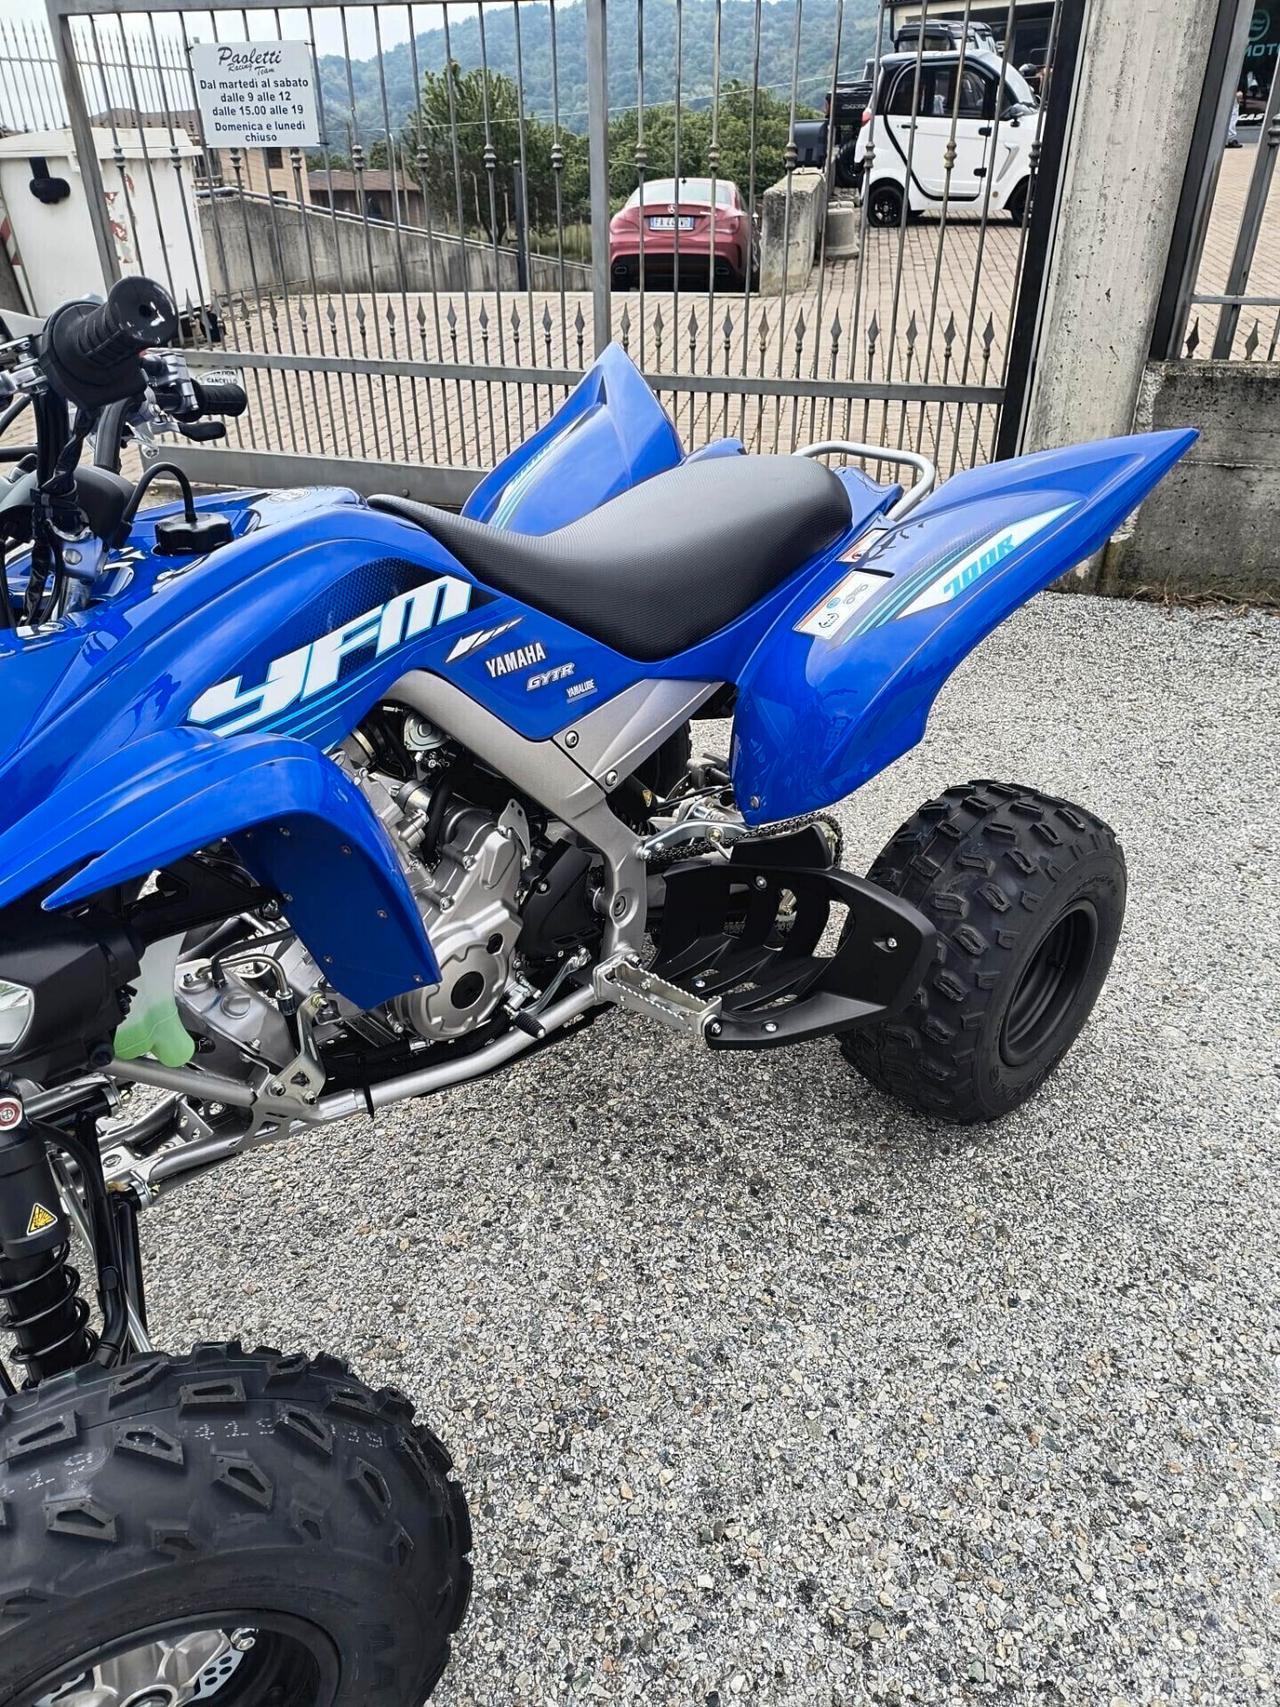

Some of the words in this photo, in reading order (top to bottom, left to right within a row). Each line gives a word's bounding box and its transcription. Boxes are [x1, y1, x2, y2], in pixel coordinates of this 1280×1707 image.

[217, 46, 282, 65] Paoletti
[227, 63, 252, 72] Racing
[254, 65, 275, 76] Team
[200, 79, 216, 89] Dal
[261, 78, 271, 88] al
[274, 77, 309, 88] sabato
[220, 93, 245, 102] dalle
[247, 92, 254, 102] 9
[257, 91, 275, 102] alle
[279, 91, 292, 101] 12
[212, 106, 236, 116] dalle
[239, 105, 266, 116] 15.00
[269, 104, 288, 115] alle
[292, 104, 304, 114] 19
[215, 121, 263, 131] Domenica
[266, 122, 272, 130] e
[245, 132, 277, 142] chiuso
[943, 534, 1015, 599] 700R
[187, 575, 472, 740] YFM
[485, 642, 547, 678] YAMAHA
[526, 661, 575, 692] GYTR
[566, 678, 595, 698] YAMALUBE
